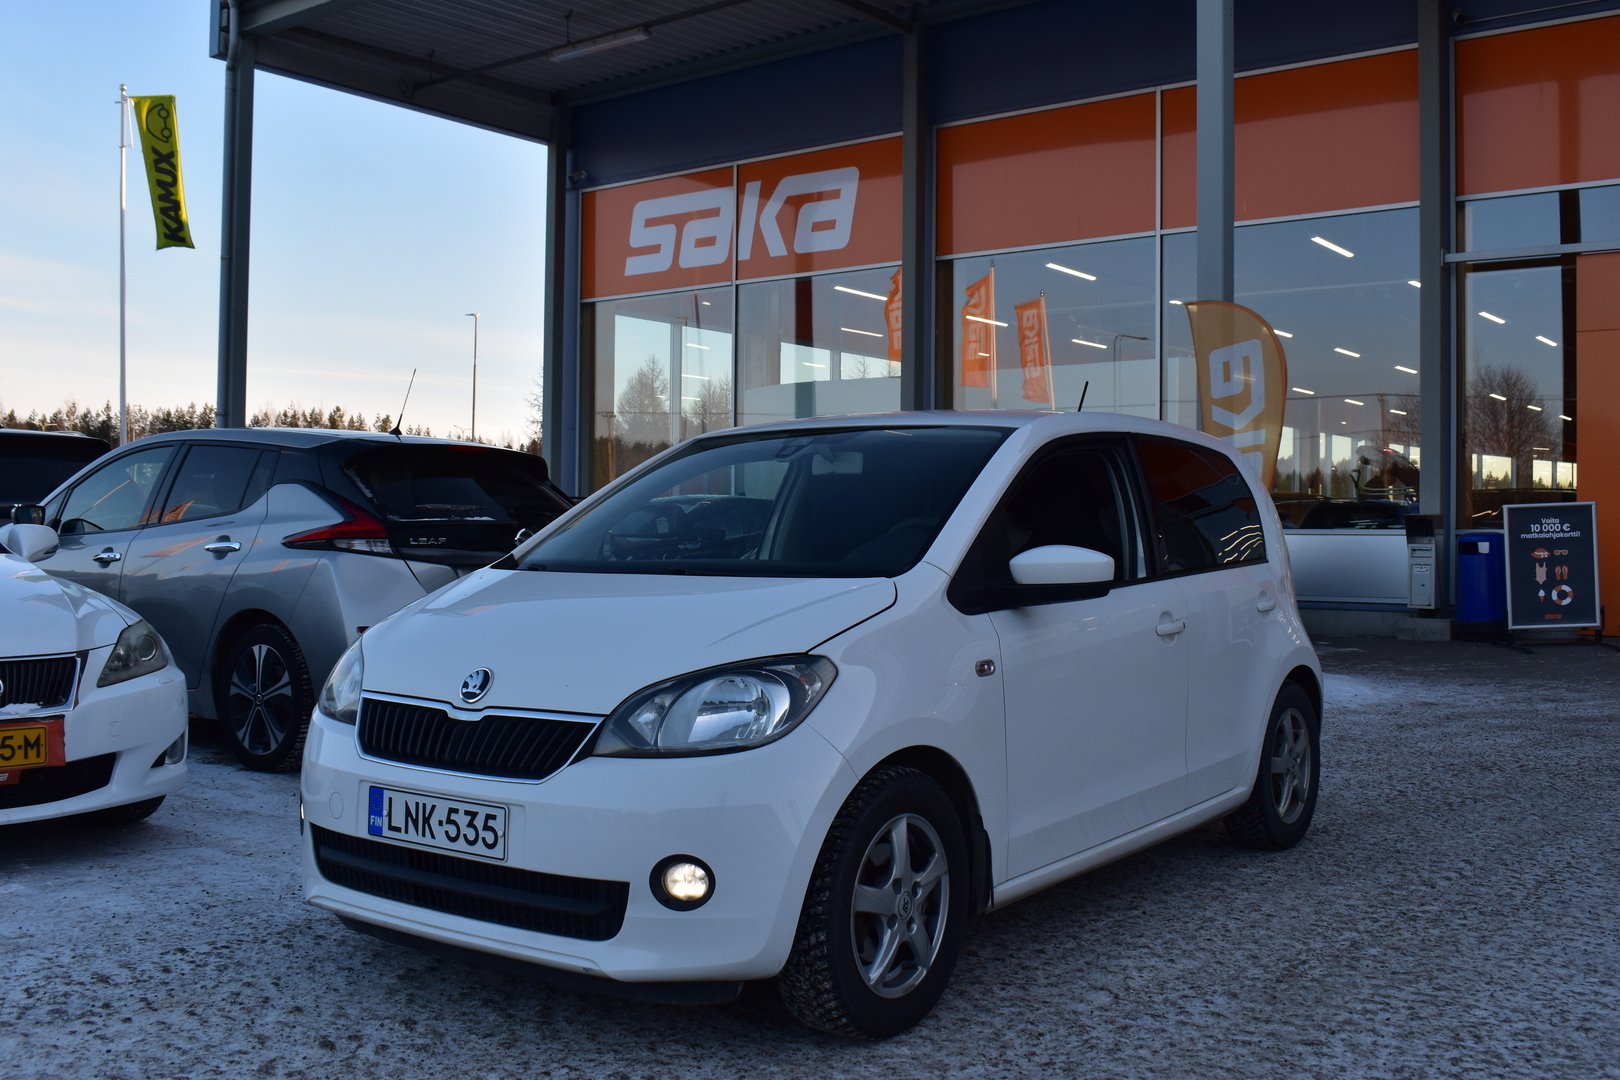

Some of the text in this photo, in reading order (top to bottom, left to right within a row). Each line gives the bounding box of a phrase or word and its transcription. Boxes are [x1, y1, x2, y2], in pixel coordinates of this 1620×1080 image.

[151, 145, 187, 243] KAMUX
[1530, 523, 1571, 532] 10 000 €
[1520, 531, 1581, 539] matkalahjakortti!
[410, 537, 447, 545] LEAF
[370, 796, 499, 850] FIN LNK-535
